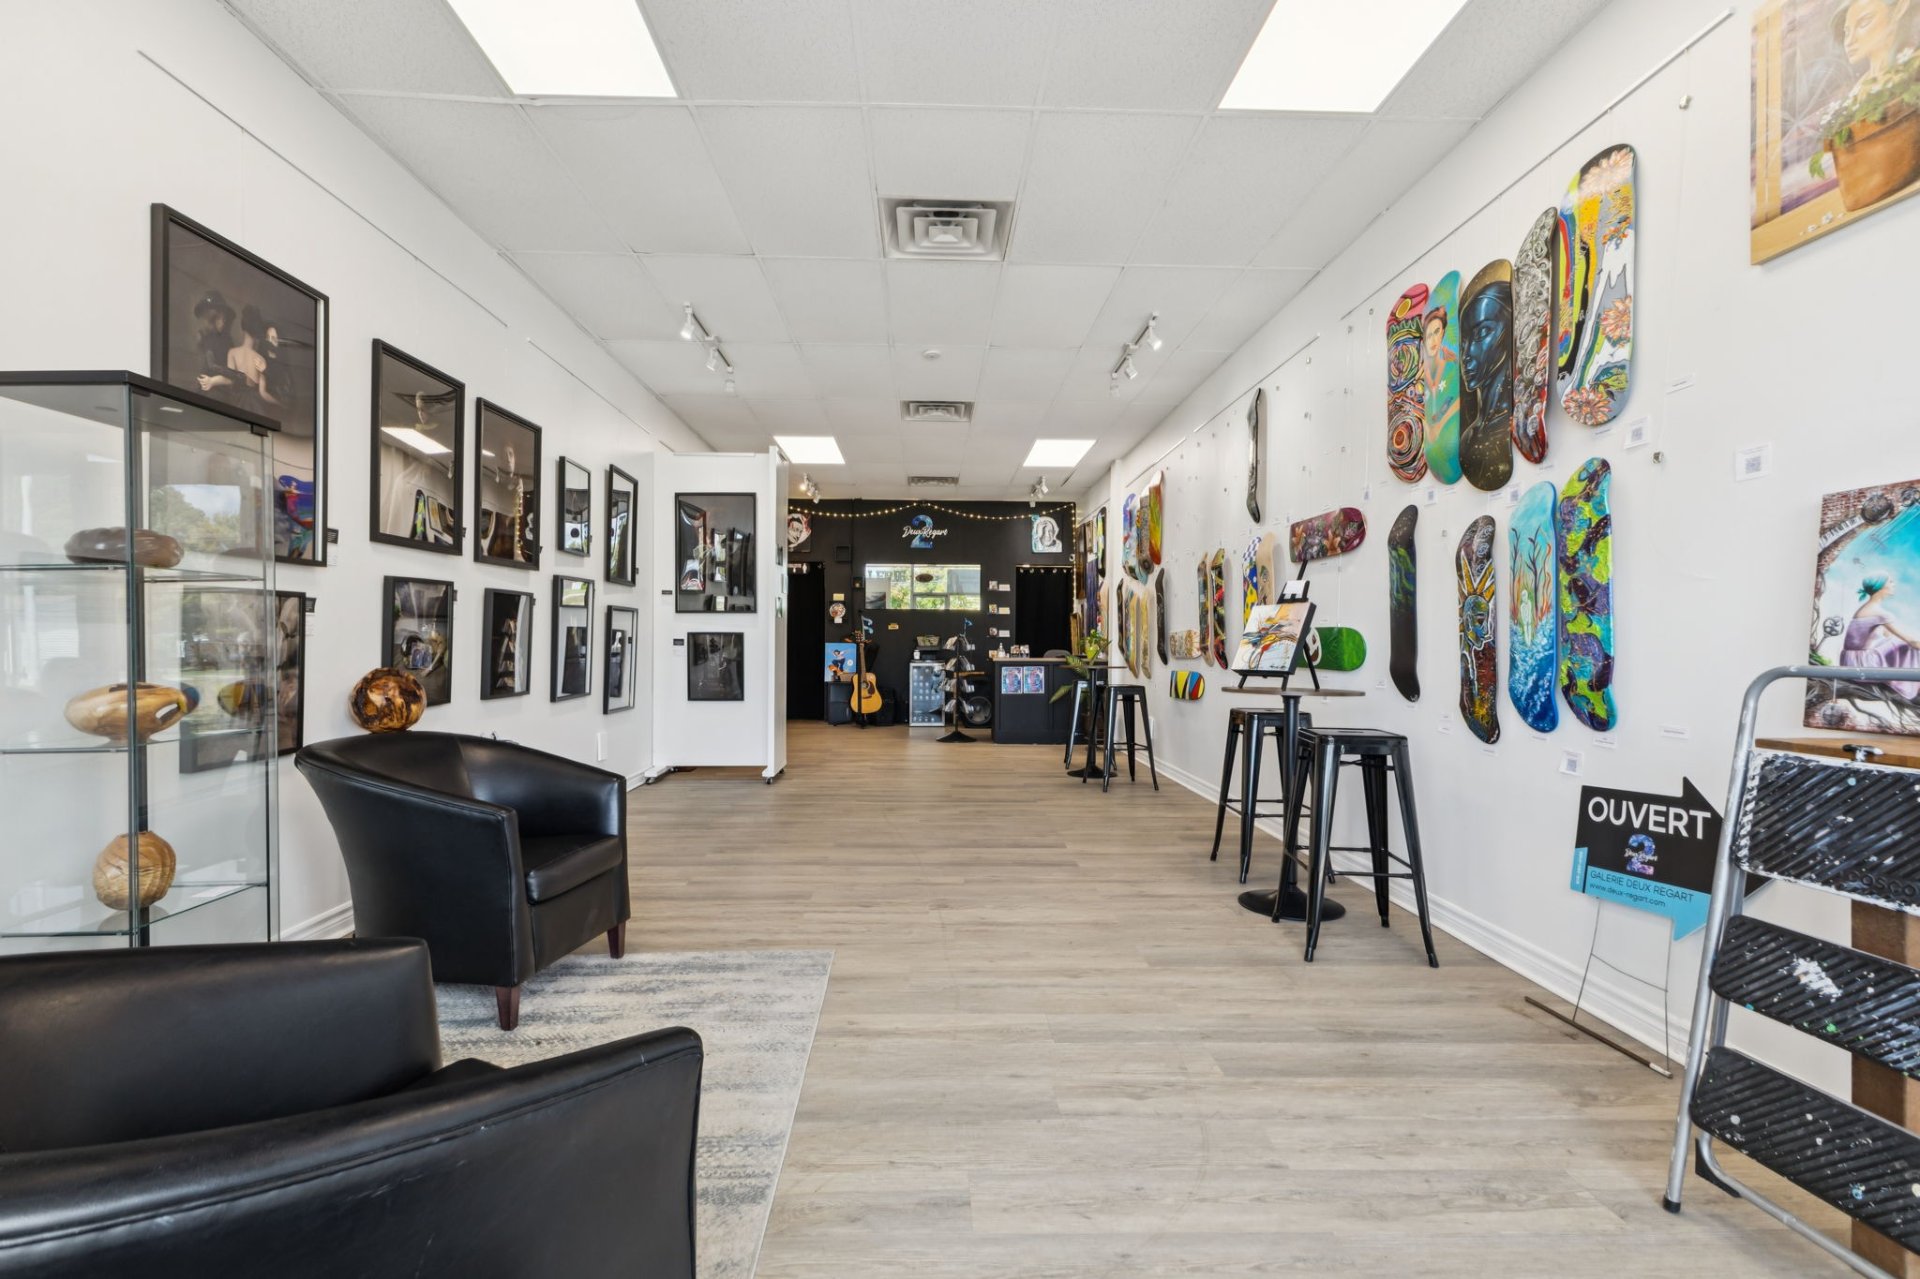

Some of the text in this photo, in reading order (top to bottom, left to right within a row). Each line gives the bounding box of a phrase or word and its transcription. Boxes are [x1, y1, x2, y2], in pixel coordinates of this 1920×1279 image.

[1588, 796, 1711, 840] OUVERT
[1589, 883, 1666, 908] www.deux-regart.com
[1590, 870, 1694, 903] GALERIE DEUX REGART
